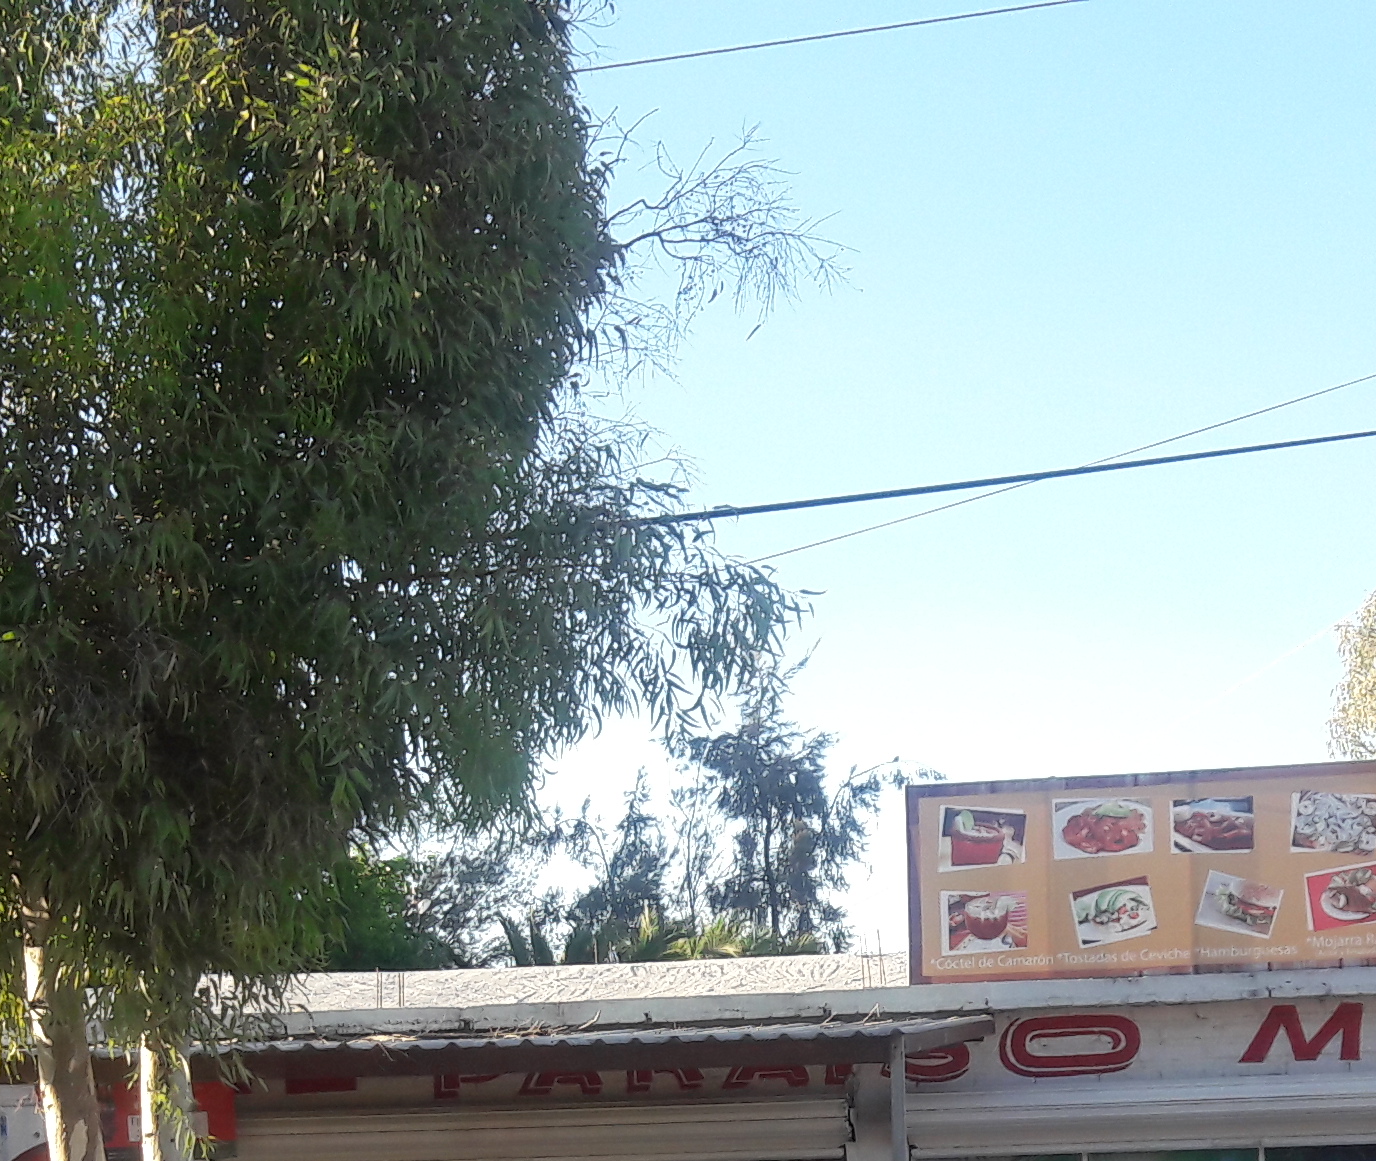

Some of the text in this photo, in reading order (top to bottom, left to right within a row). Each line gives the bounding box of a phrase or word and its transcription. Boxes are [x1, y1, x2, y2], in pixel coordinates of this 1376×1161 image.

[978, 956, 994, 968] de
[997, 953, 1054, 967] Camarón
[1121, 949, 1135, 962] de
